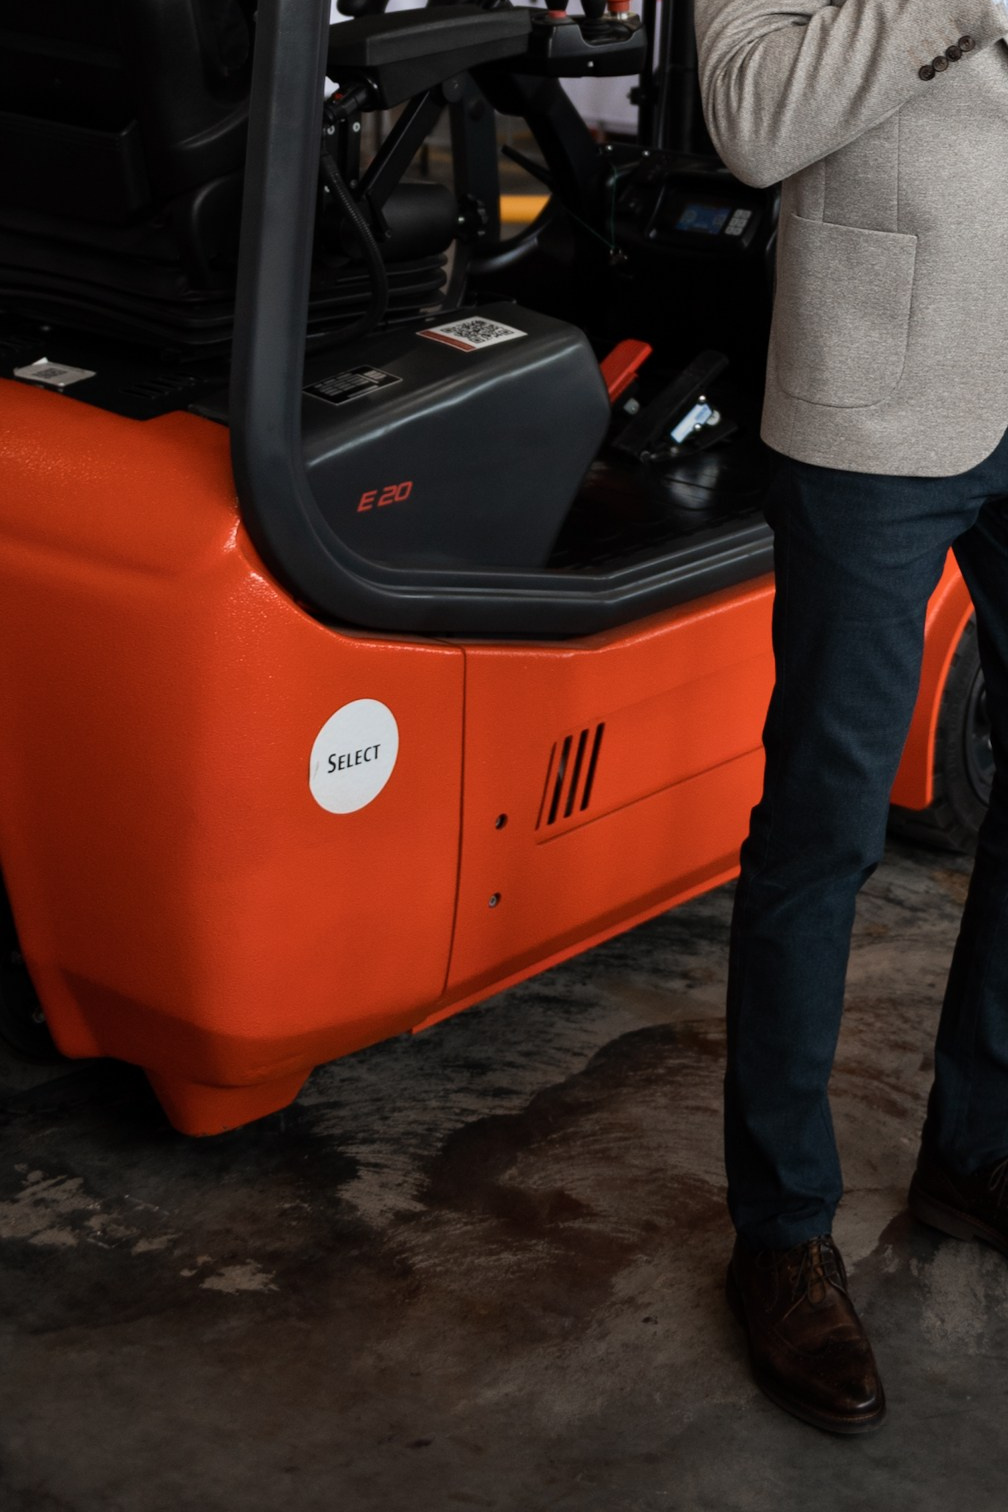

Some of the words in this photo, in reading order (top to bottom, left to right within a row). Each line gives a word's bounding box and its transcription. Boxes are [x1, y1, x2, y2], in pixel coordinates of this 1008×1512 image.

[357, 490, 378, 513] E
[377, 481, 413, 507] 20
[327, 743, 382, 774] SELECT
